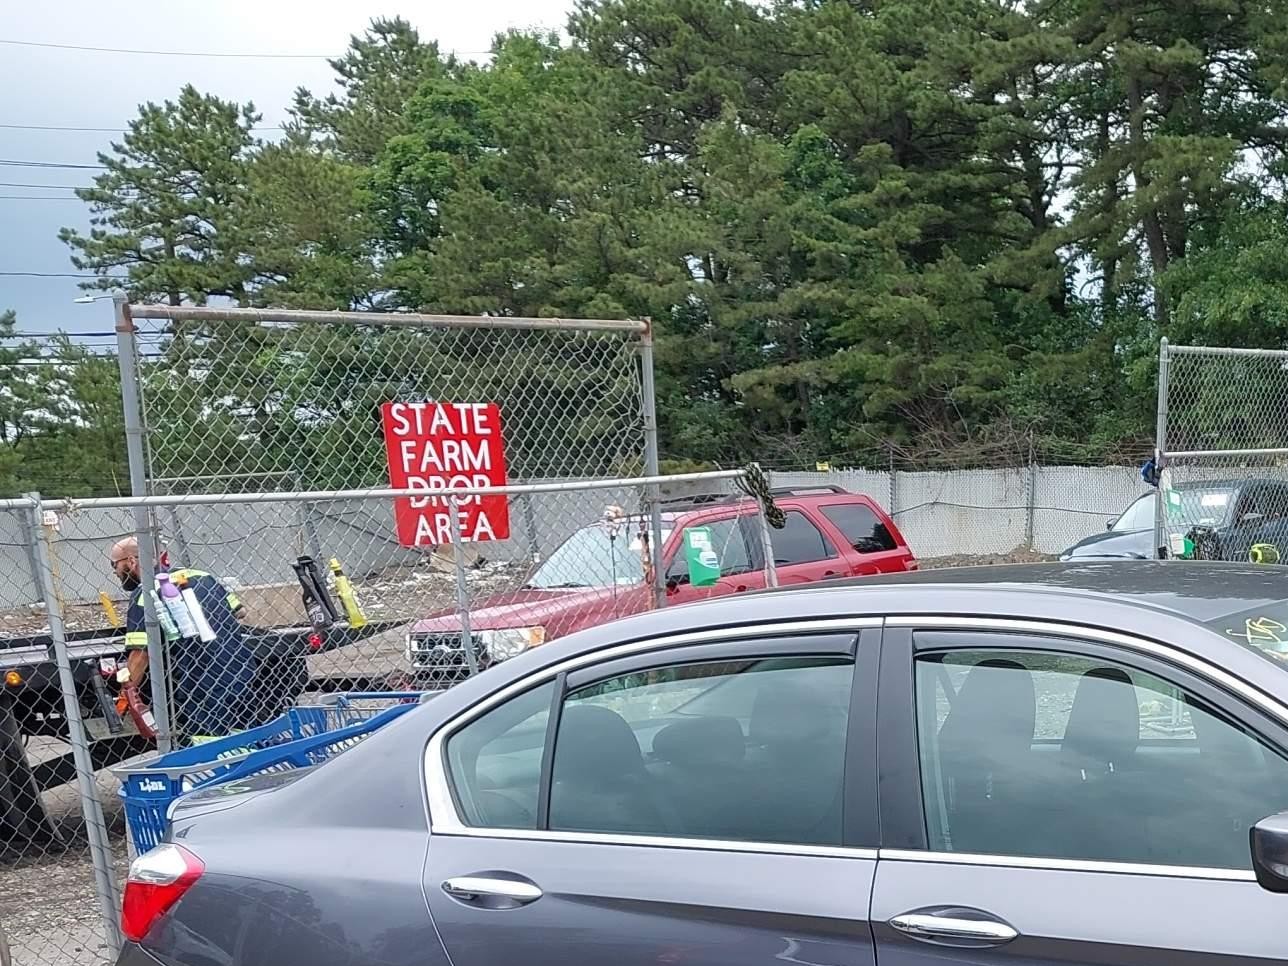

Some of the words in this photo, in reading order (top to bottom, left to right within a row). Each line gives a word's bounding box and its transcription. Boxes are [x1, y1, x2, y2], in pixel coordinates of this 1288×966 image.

[391, 403, 491, 435] STATE
[401, 439, 491, 472] FARM
[407, 474, 491, 507] DROP
[414, 512, 496, 546] AREA
